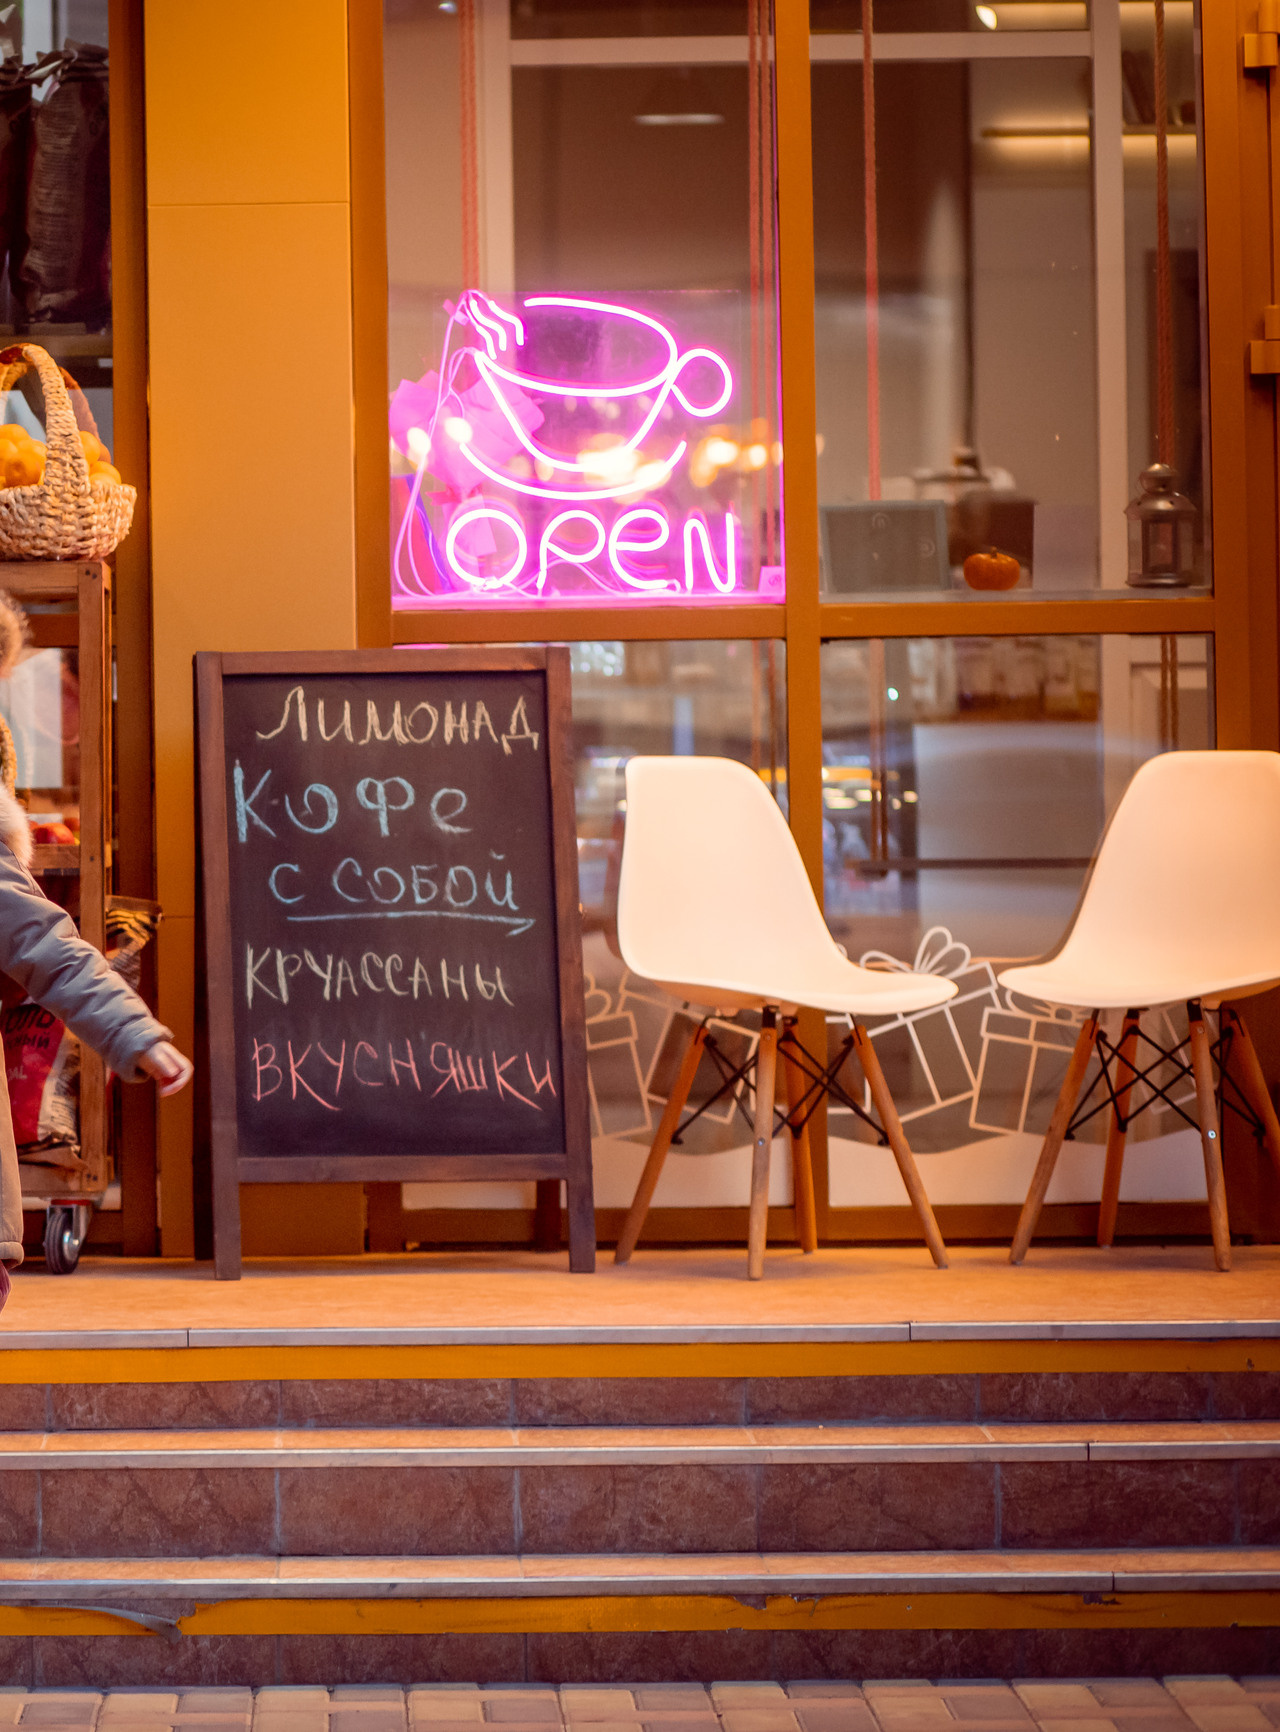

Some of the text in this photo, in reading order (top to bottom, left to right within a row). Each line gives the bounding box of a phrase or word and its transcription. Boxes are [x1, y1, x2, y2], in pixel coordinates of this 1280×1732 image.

[256, 685, 540, 755] ЛИМОНАД
[333, 850, 519, 911] СОБОЙ
[246, 943, 515, 1009] КРУАССАНЫ
[252, 1038, 557, 1111] ВКУСНЯШКИ
